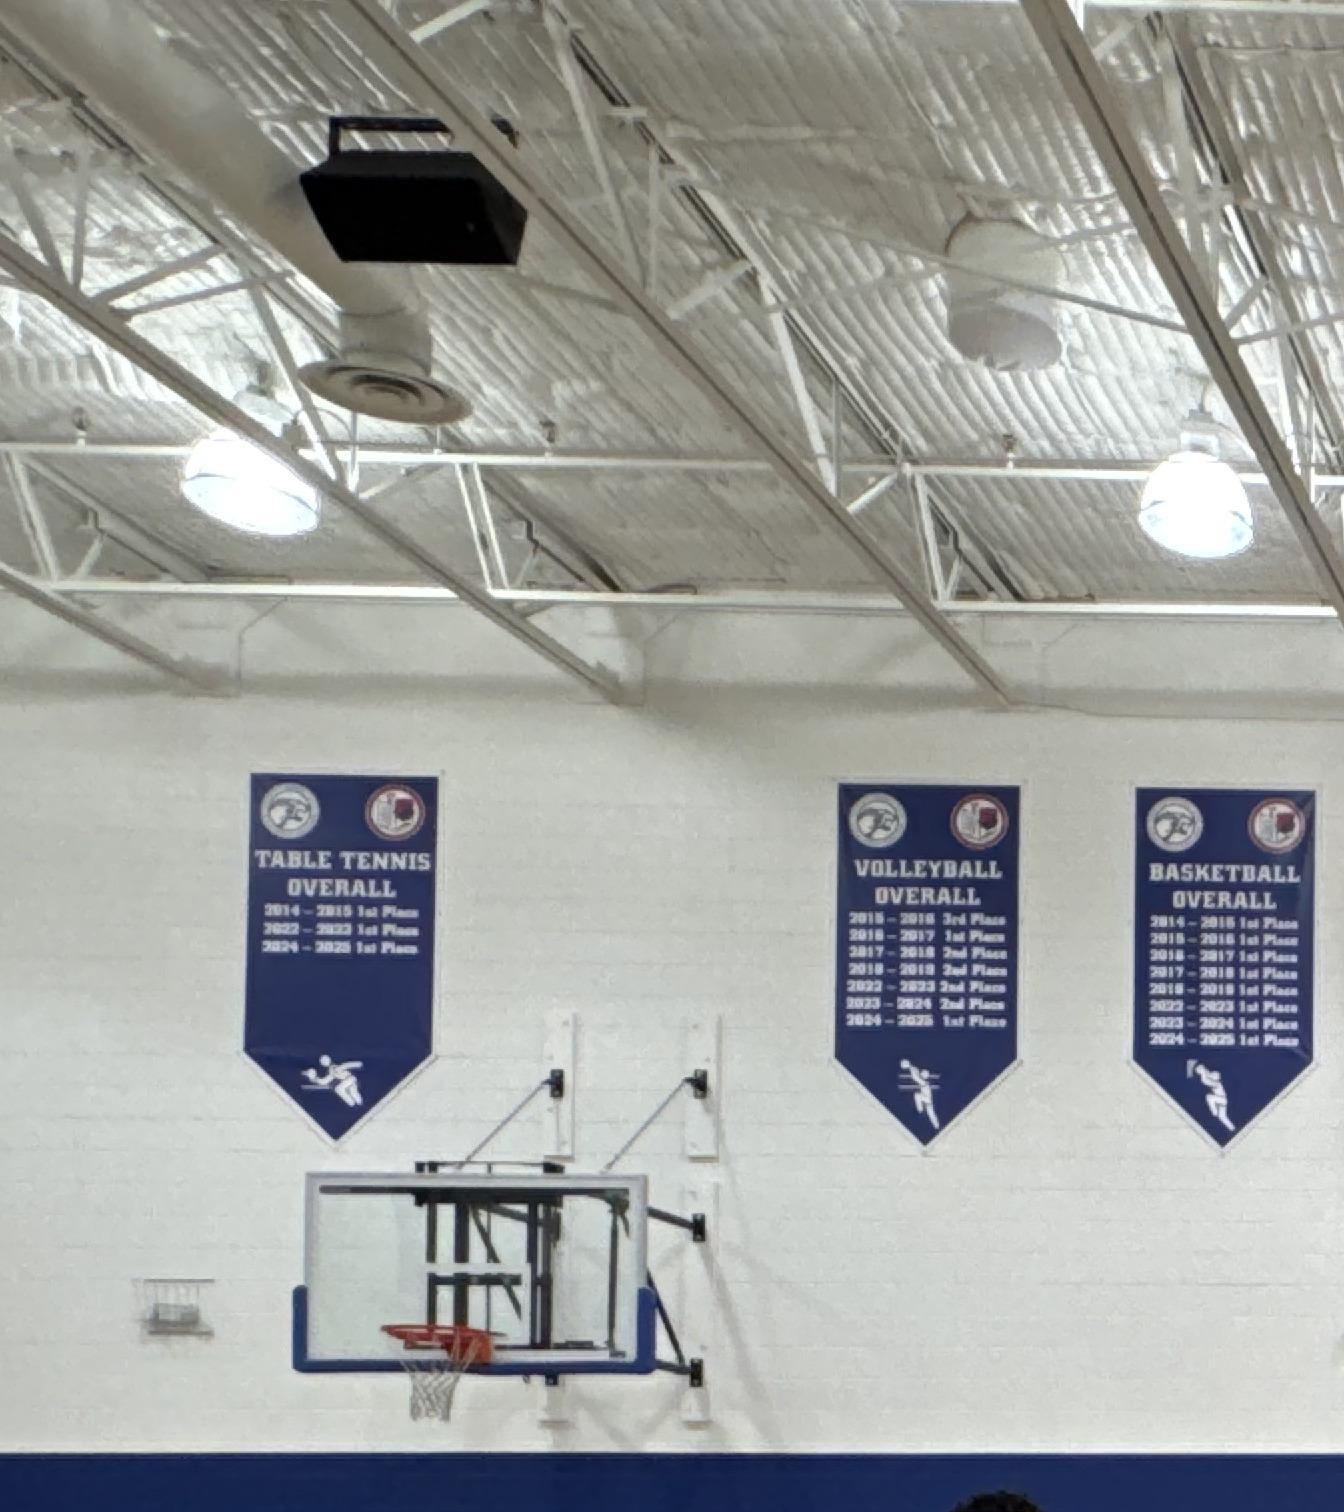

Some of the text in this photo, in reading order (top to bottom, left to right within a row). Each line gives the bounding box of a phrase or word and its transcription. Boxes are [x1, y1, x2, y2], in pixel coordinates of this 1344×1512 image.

[255, 850, 431, 870] TABLE TENNIS
[855, 859, 1003, 878] VOLLEYBALL
[1149, 864, 1301, 883] BASKETBALL
[287, 878, 397, 897] OVERALL
[875, 887, 981, 905] OVERALL
[1172, 891, 1277, 909] OVERALL
[382, 904, 419, 917] Place
[970, 913, 1006, 926] Place
[1263, 917, 1298, 929] Place
[382, 923, 419, 936] Place
[969, 930, 1005, 943] Place
[1263, 934, 1298, 946] Place
[381, 941, 418, 954] Place
[971, 947, 1007, 959] Place
[1263, 950, 1298, 963] Place
[972, 964, 1007, 977] Place
[1263, 968, 1298, 980] Place
[969, 981, 1006, 994] Place
[1263, 984, 1298, 996] Place
[969, 998, 1005, 1011] Place
[1263, 1001, 1298, 1013] Place
[969, 1015, 1007, 1028] Place
[1263, 1018, 1298, 1030] Place
[1263, 1034, 1298, 1046] Place
